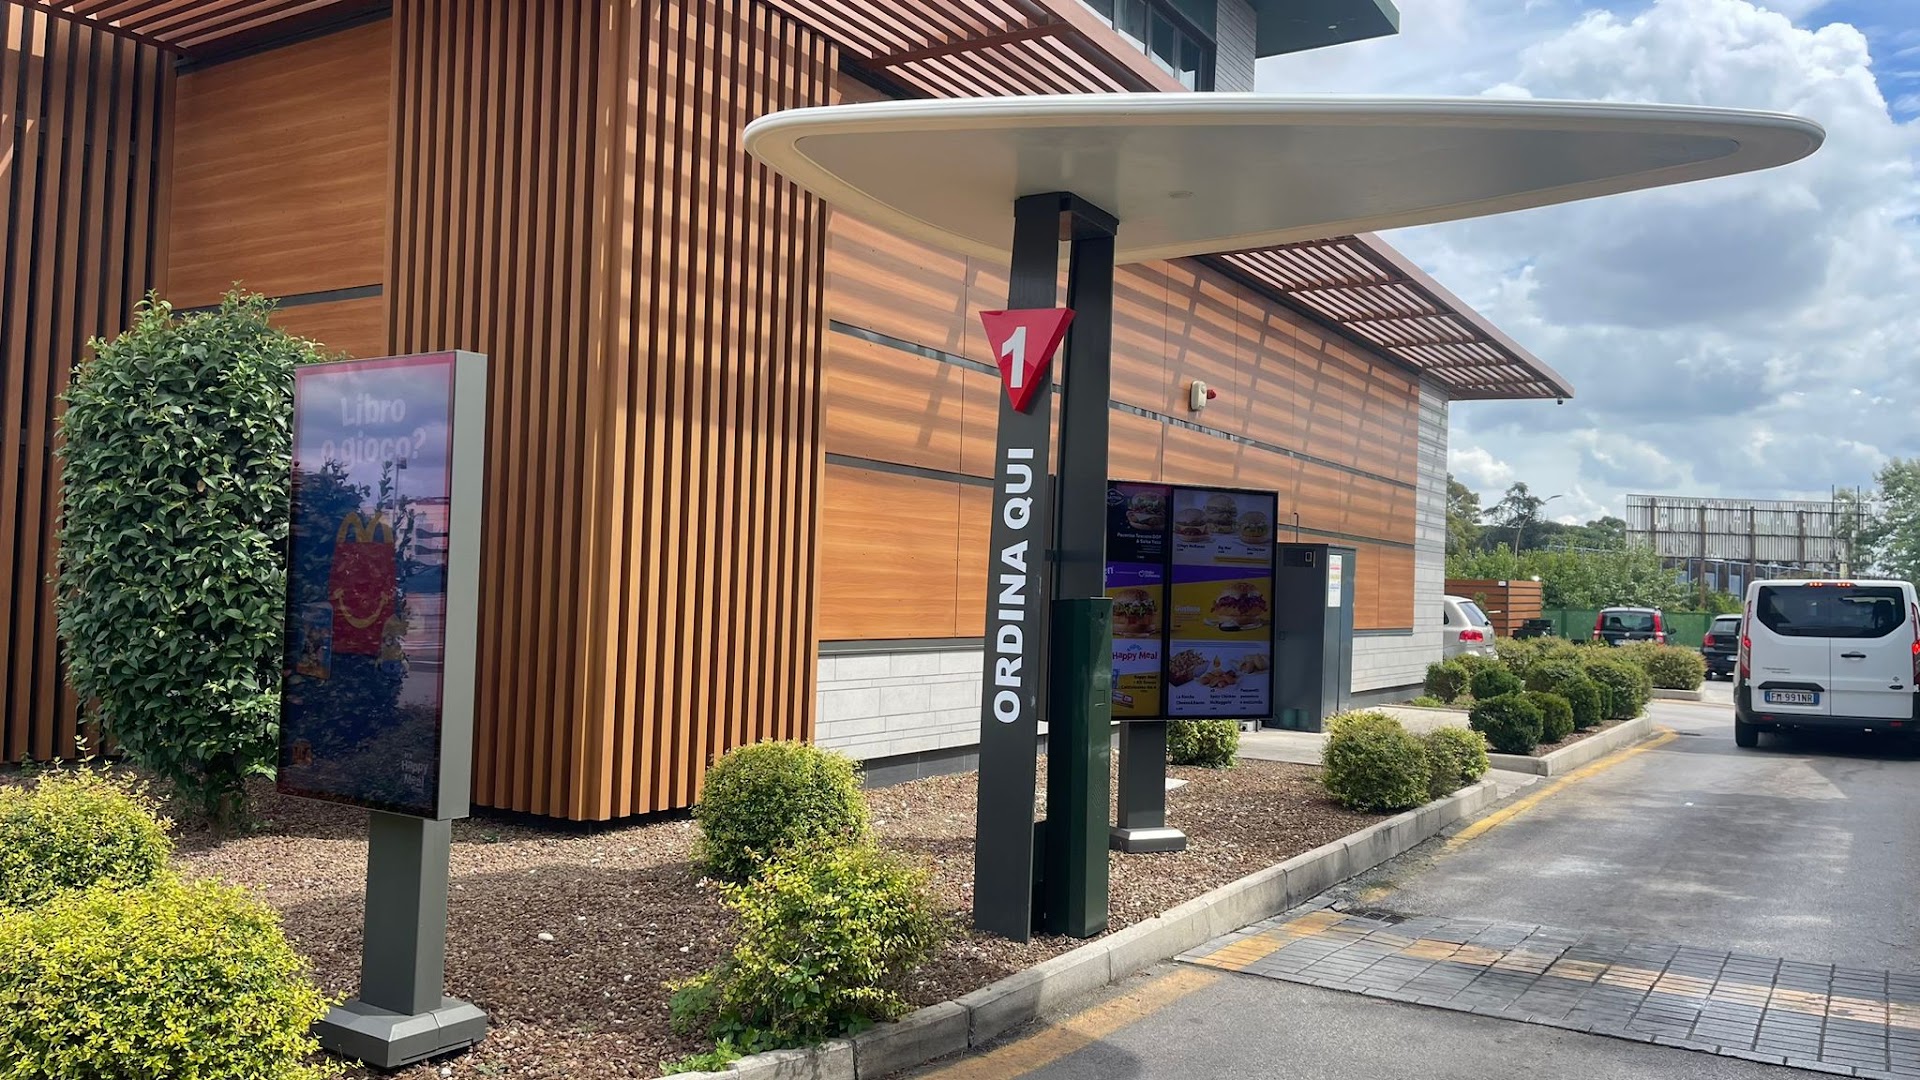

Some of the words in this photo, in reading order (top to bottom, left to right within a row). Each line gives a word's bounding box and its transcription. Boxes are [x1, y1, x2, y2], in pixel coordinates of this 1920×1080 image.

[1001, 326, 1026, 388] 1
[340, 393, 407, 427] Libro
[320, 439, 333, 460] o
[340, 427, 427, 466] gioco?
[1003, 448, 1034, 531] QUI
[993, 540, 1029, 724] ORDINA
[1112, 651, 1138, 661] Happy
[1138, 651, 1158, 660] Meal
[1771, 692, 1782, 702] FM
[401, 760, 429, 776] Happy
